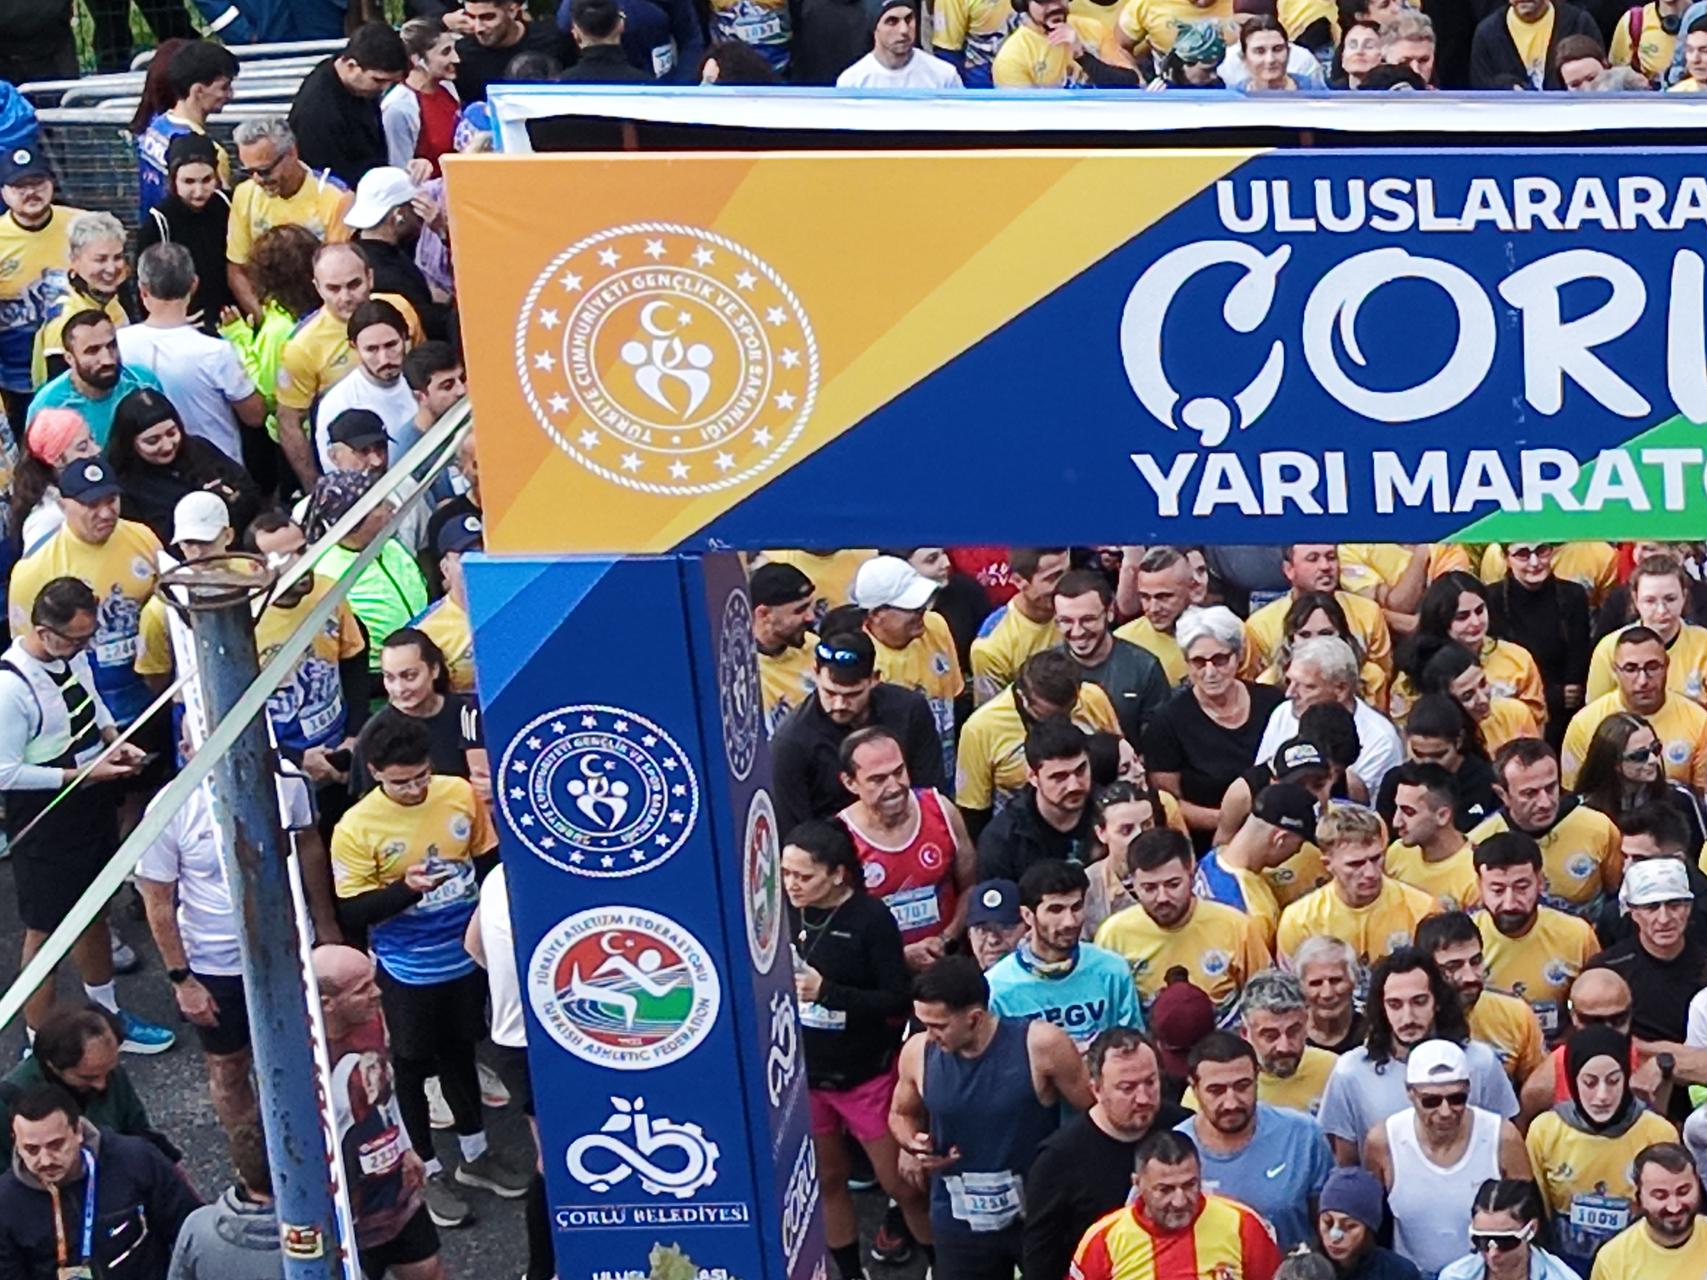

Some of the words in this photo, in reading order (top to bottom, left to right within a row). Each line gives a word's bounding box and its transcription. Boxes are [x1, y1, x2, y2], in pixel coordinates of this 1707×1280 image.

[631, 272, 714, 298] GENÇLİK
[714, 293, 738, 318] VE
[571, 279, 629, 387] CUMHURİYETİ
[735, 314, 763, 361] SPOR
[585, 384, 652, 444] TÜRKİYE
[1131, 450, 1348, 517] YARI
[556, 1208, 625, 1227] ÇORLU
[633, 1204, 749, 1224] BELEDİYESİ
